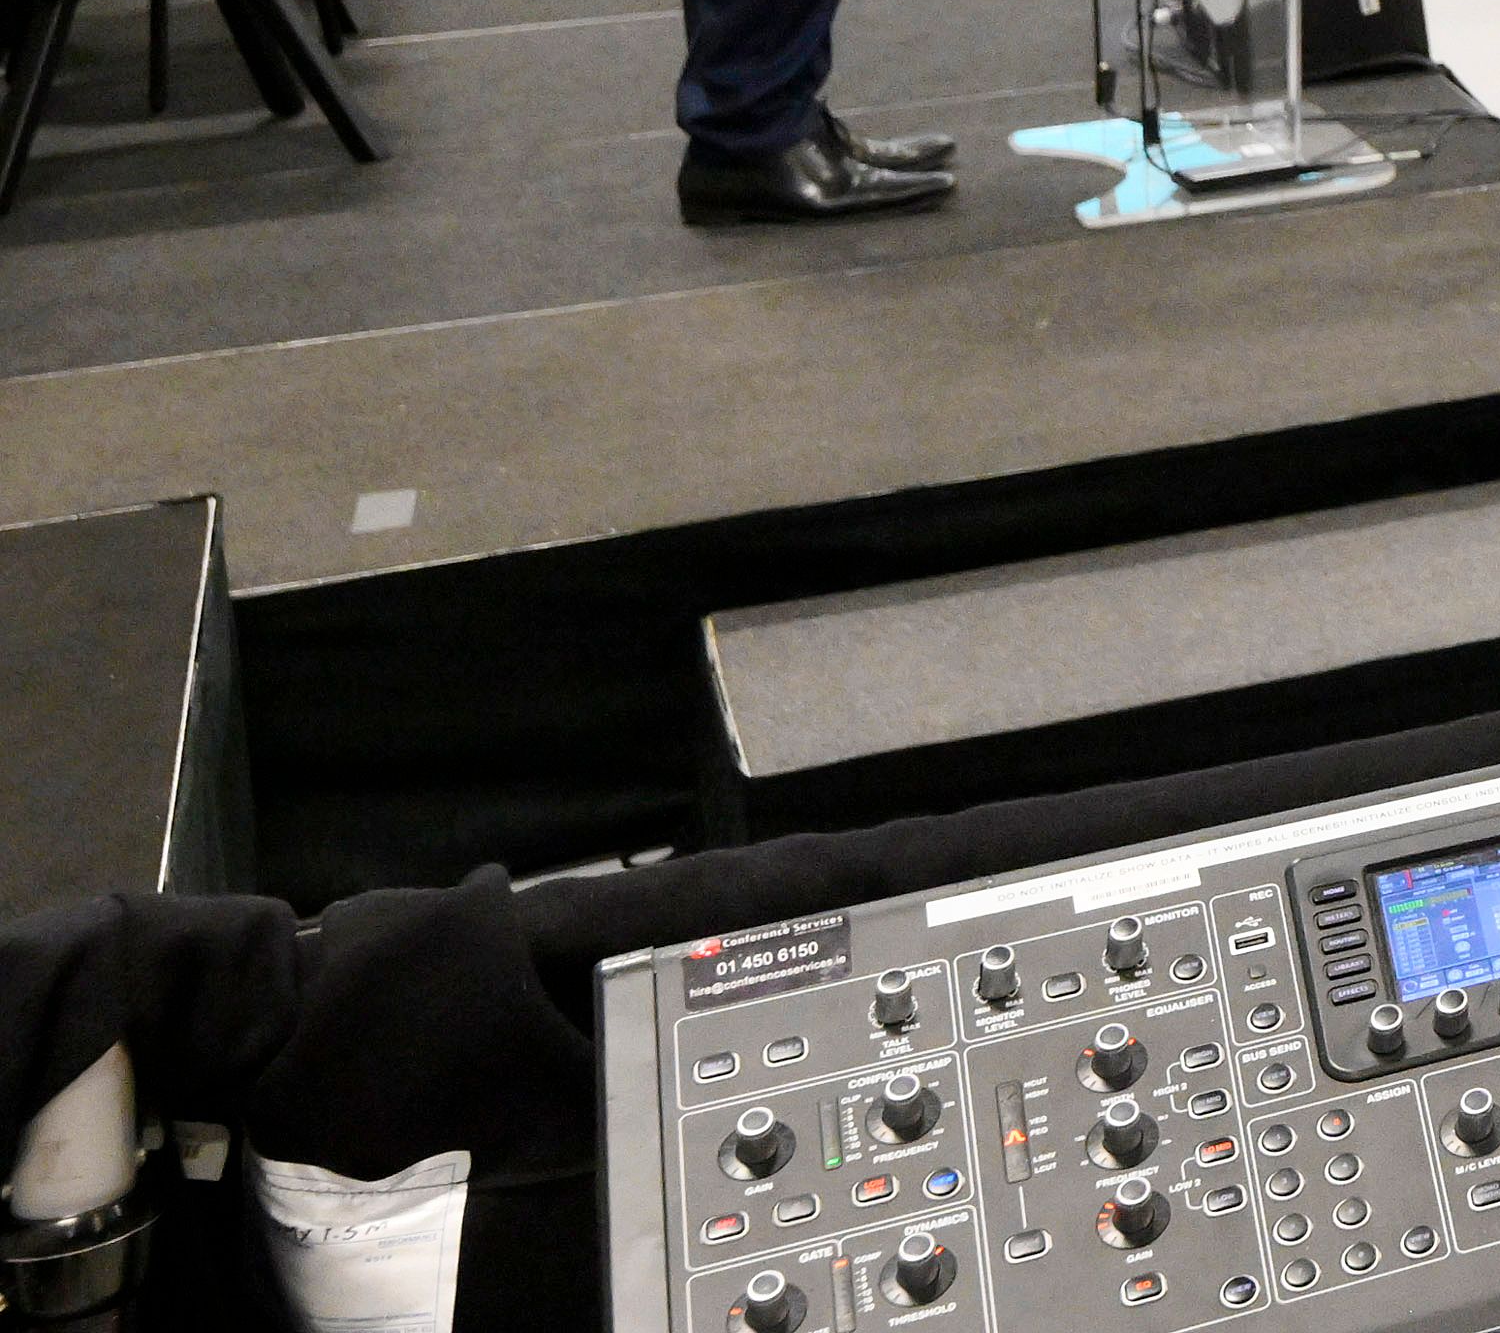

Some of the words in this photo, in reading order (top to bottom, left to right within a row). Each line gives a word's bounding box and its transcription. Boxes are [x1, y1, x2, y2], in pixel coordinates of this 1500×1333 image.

[1020, 885, 1047, 897] NOT
[1119, 861, 1157, 877] SHOW
[1160, 853, 1193, 867] DATA
[1223, 837, 1263, 853] WIPES
[1266, 831, 1290, 844] ALL
[1416, 793, 1473, 811] CONSOLE
[1249, 889, 1274, 902] REC
[1144, 905, 1200, 926] MONITOR
[722, 923, 789, 948] Conference
[793, 914, 843, 933] Services
[716, 960, 737, 977] 01
[741, 952, 774, 970] 450
[777, 941, 819, 962] 6150
[1146, 993, 1214, 1017] EQUALISER
[879, 1044, 914, 1059] LEVEL
[882, 1036, 910, 1048] TALK
[1242, 1049, 1267, 1064] BUS
[1270, 1041, 1302, 1058] SEND
[1366, 1085, 1411, 1104] ASSIGN
[872, 1141, 939, 1164] FREQUENCY
[904, 1212, 970, 1235] DYNAMICS
[798, 1246, 834, 1263] GATE
[888, 1302, 957, 1327] THRESHOLD
